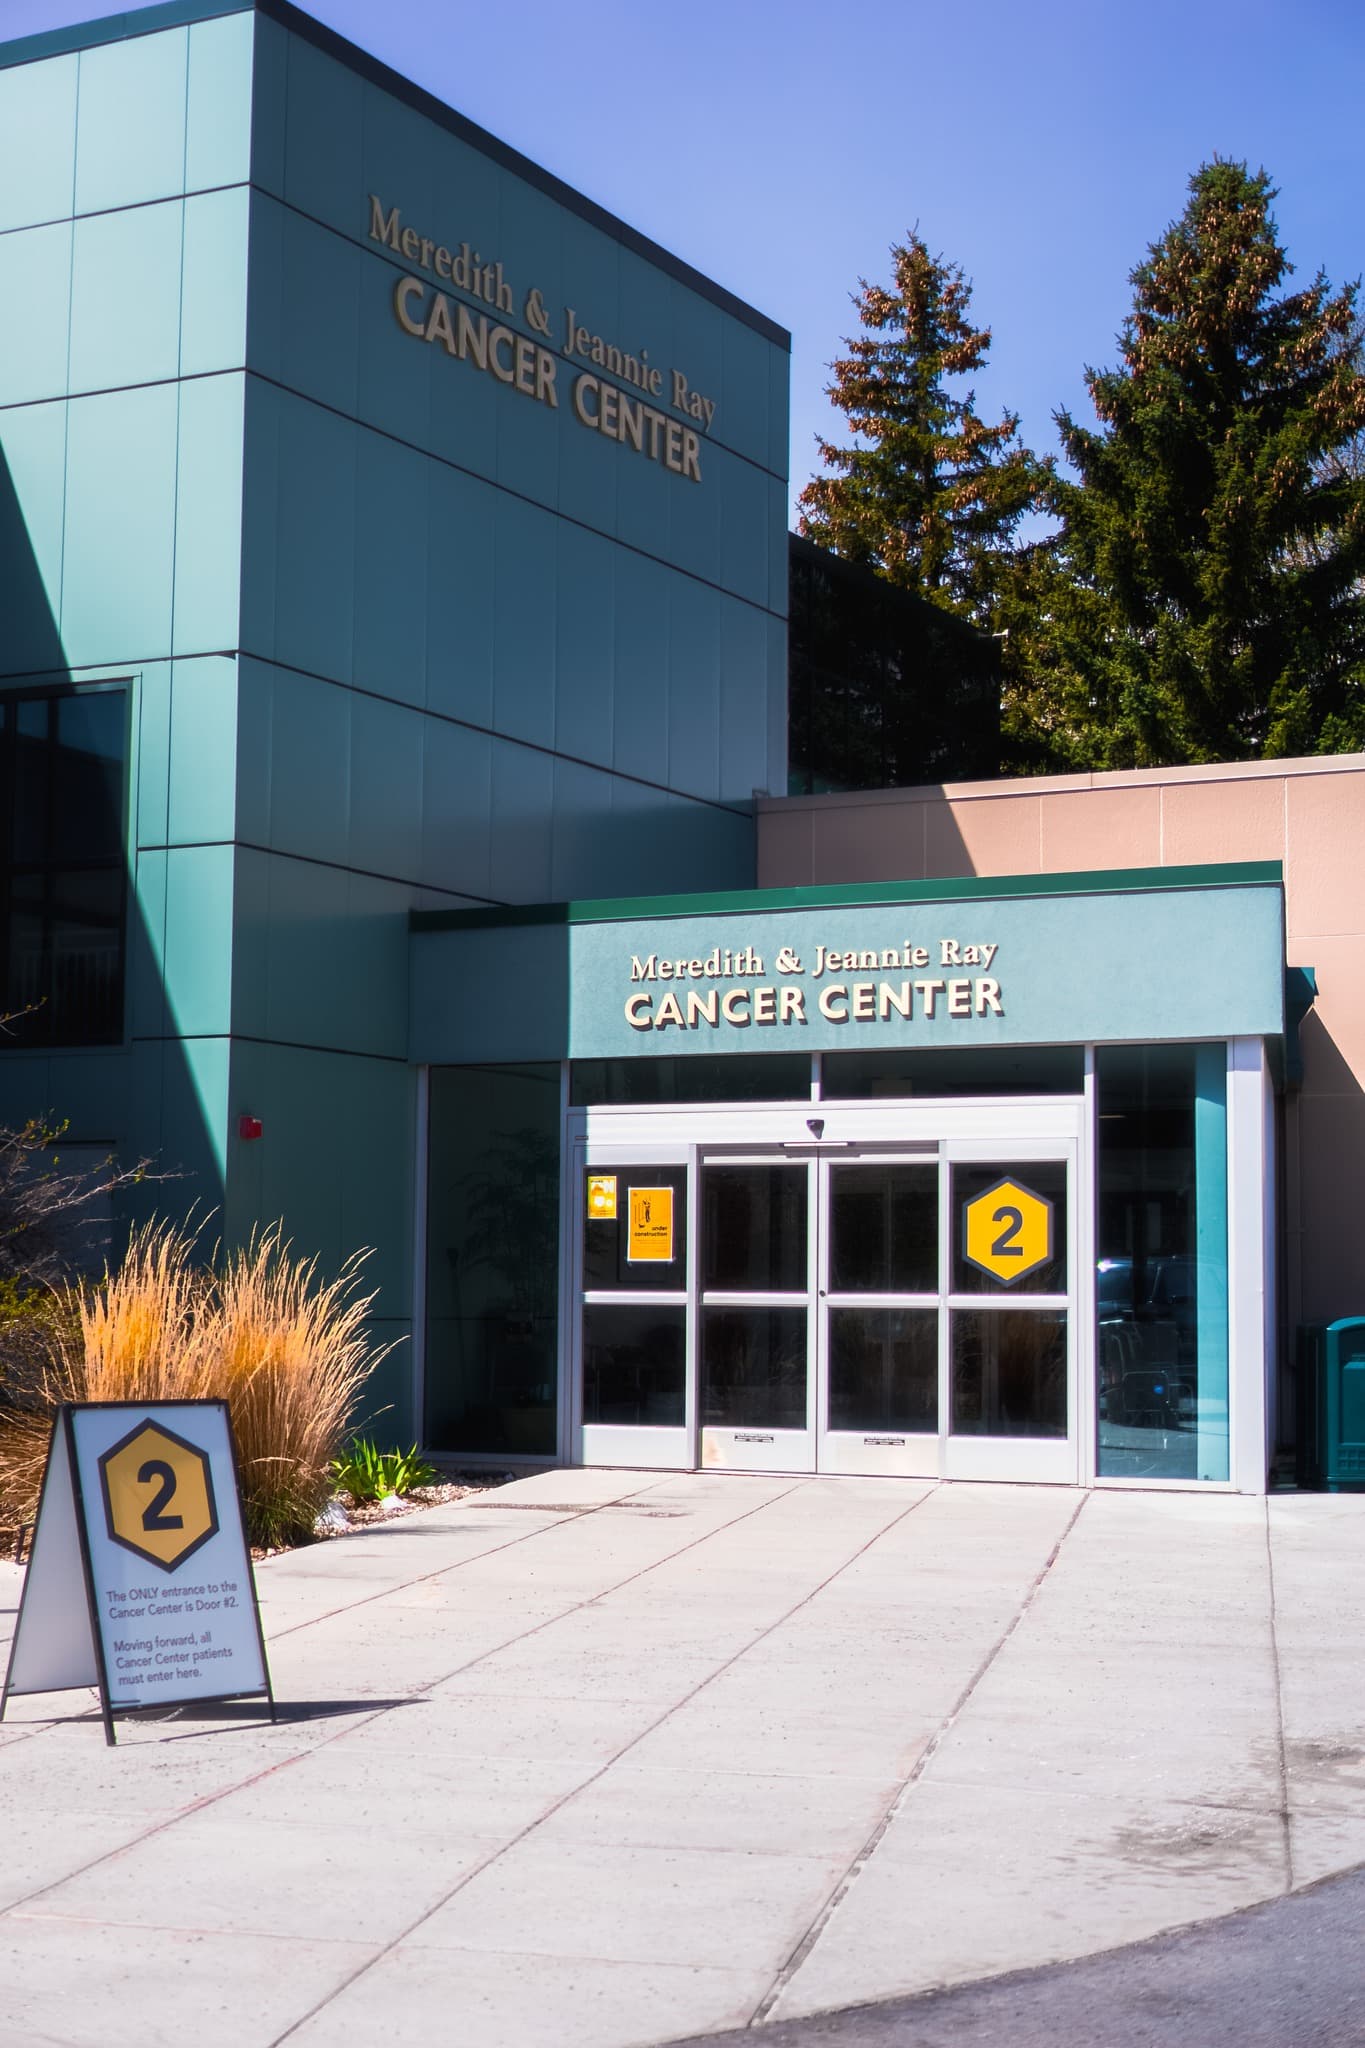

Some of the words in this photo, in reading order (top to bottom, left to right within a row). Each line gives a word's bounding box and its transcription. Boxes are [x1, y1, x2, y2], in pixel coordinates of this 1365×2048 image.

[368, 194, 513, 315] Meredith
[526, 288, 552, 336] &
[563, 307, 662, 396] Jeannie
[671, 368, 716, 432] Ray
[395, 276, 558, 407] CANCER
[576, 374, 702, 482] CENTER
[630, 947, 764, 981] Meredith
[775, 948, 804, 973] &
[812, 941, 929, 976] Jeannie
[939, 939, 998, 969] Ray
[624, 986, 805, 1027] CANCER
[818, 978, 1003, 1020] CENTER
[991, 1206, 1024, 1256] 2
[137, 1459, 185, 1532] 2
[106, 1591, 126, 1602] The
[128, 1587, 159, 1601] ONLY
[161, 1584, 205, 1598] entrance
[208, 1583, 219, 1594] to
[220, 1581, 238, 1592] the
[109, 1607, 146, 1619] Cancer
[148, 1603, 182, 1616] Center
[185, 1601, 193, 1612] is
[195, 1600, 221, 1611] Door
[223, 1597, 239, 1608] #2.
[113, 1639, 153, 1652] Moving
[155, 1632, 198, 1648] forward,
[200, 1631, 212, 1643] all
[116, 1657, 152, 1669] Cancer
[155, 1652, 190, 1665] Center
[193, 1647, 233, 1664] patients
[118, 1673, 144, 1686] must
[147, 1671, 174, 1683] enter
[176, 1667, 202, 1679] here.
